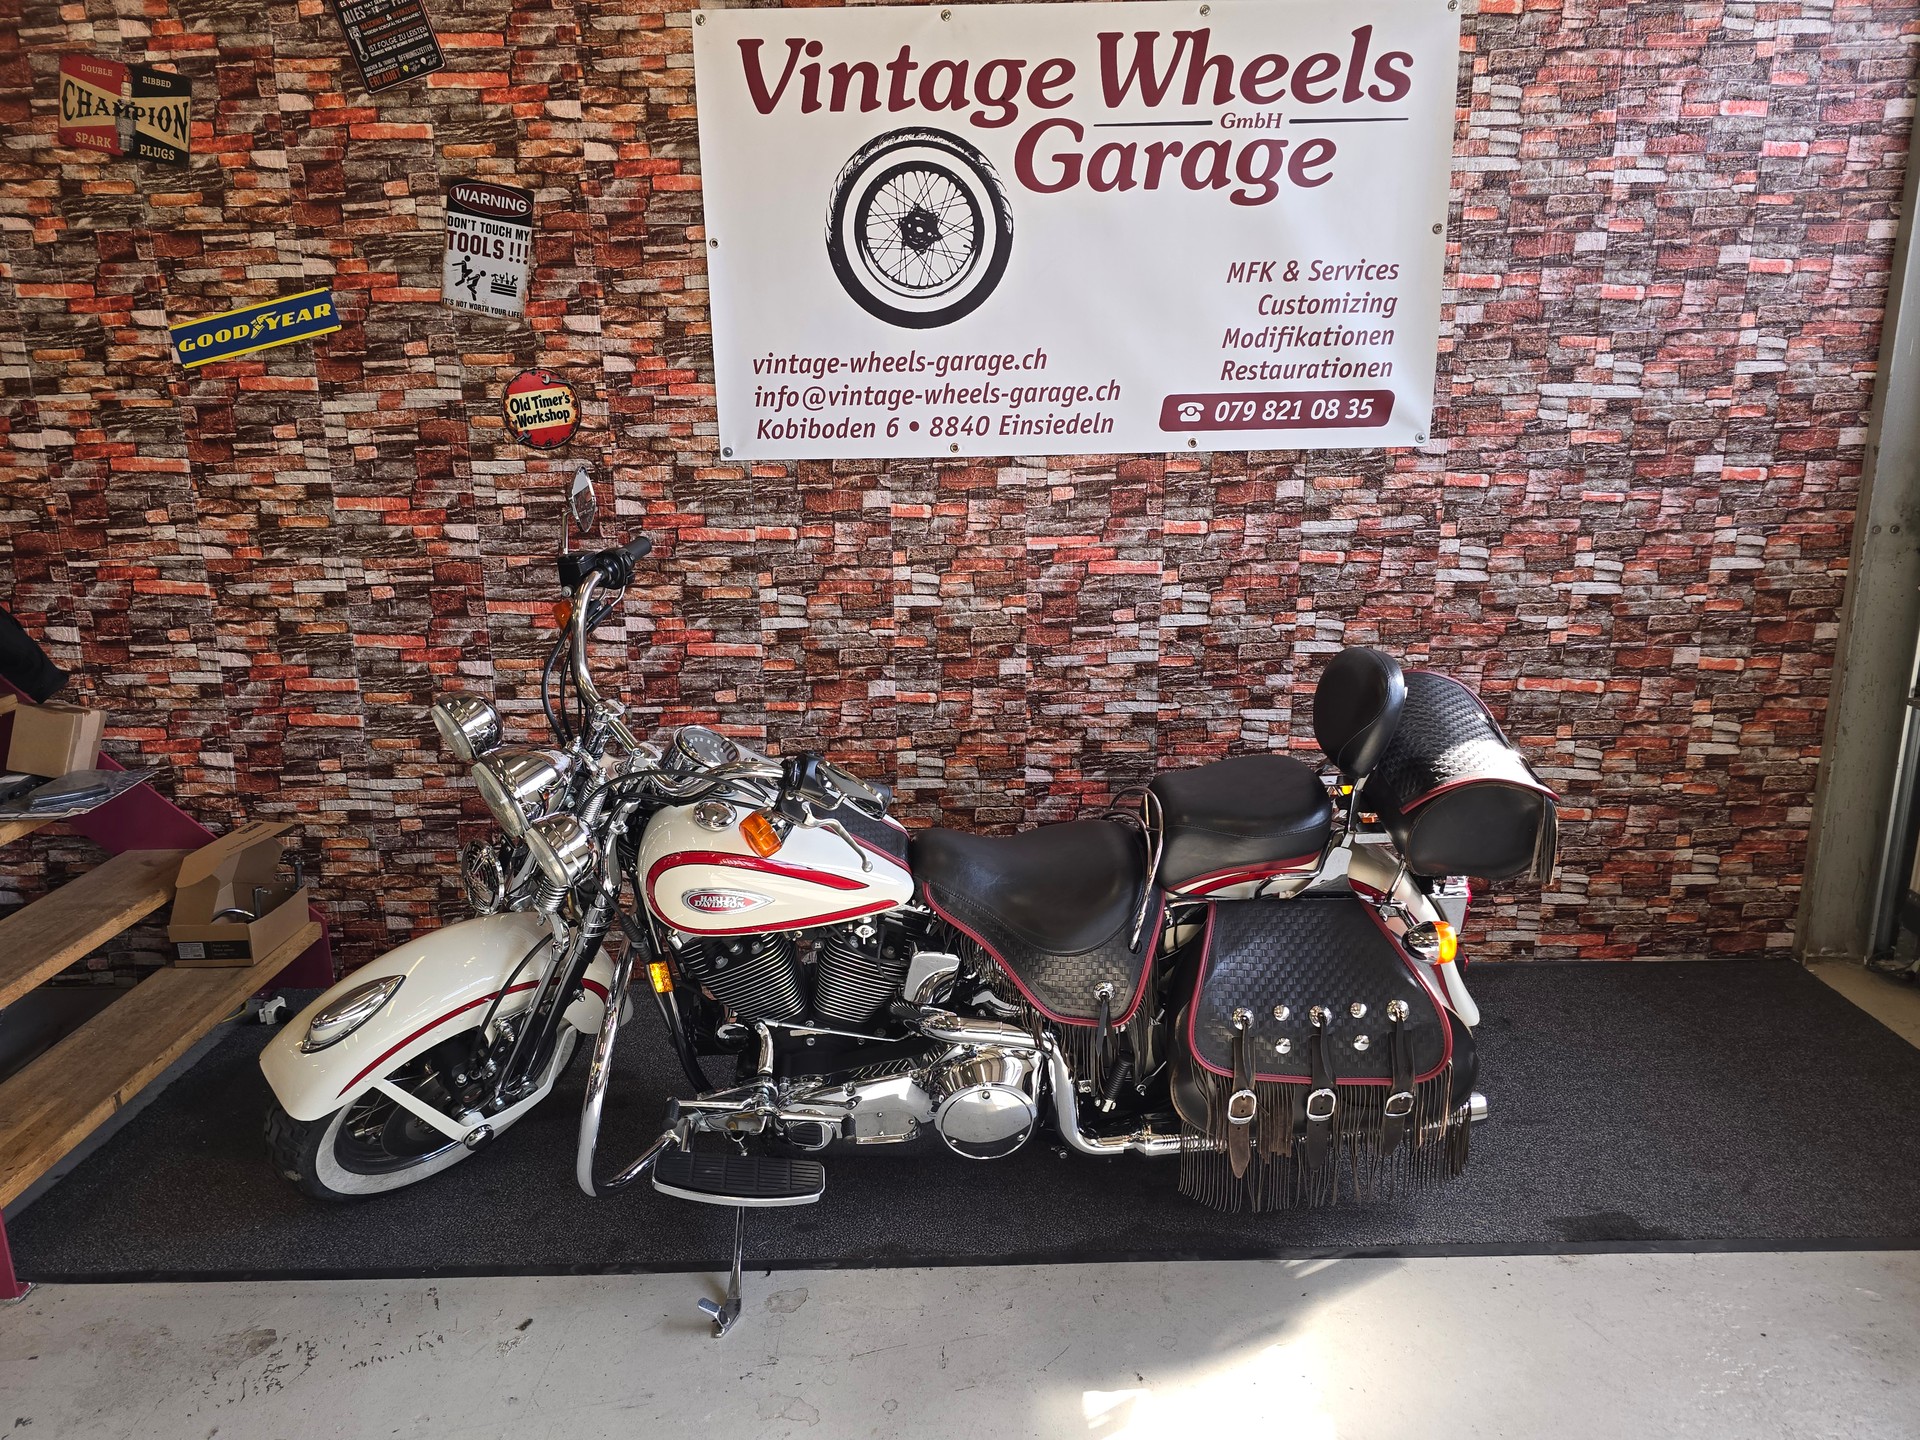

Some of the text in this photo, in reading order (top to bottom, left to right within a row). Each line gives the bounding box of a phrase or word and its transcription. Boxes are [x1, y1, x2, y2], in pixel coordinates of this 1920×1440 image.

[342, 5, 366, 25] ALLES
[367, 43, 378, 52] IST
[378, 37, 398, 49] FOLGE
[398, 33, 407, 42] ZU
[406, 25, 428, 38] LEISTEN
[81, 64, 172, 88] DOUBLE RIBBED
[737, 24, 1414, 128] Vintage Wheels
[62, 79, 189, 143] CHAMPION
[1220, 112, 1283, 130] GmbH
[75, 132, 175, 160] SPARK PLUGS
[1014, 118, 1336, 206] Garage
[455, 187, 527, 213] WARNING
[447, 215, 530, 241] DON'T TOUCH MY
[447, 230, 504, 260] TOOLS
[1227, 259, 1400, 283] MFK & Services
[455, 300, 467, 309] NOT
[468, 301, 489, 313] WORTH
[490, 305, 507, 316] YOUR
[1258, 292, 1398, 319] Customizing
[1222, 325, 1394, 353] Modifikationen
[753, 348, 1047, 378] vintage-wheels-garage.ch
[1220, 357, 1393, 381] Restaurationen
[510, 391, 570, 414] Old Timer's
[755, 379, 1121, 412] info@vintage-wheels-garage.ch
[515, 409, 570, 428] Workshop
[1214, 399, 1375, 422] 079 821 08 35
[757, 412, 1114, 440] Kobiboden 6 8840 Einsiedeln
